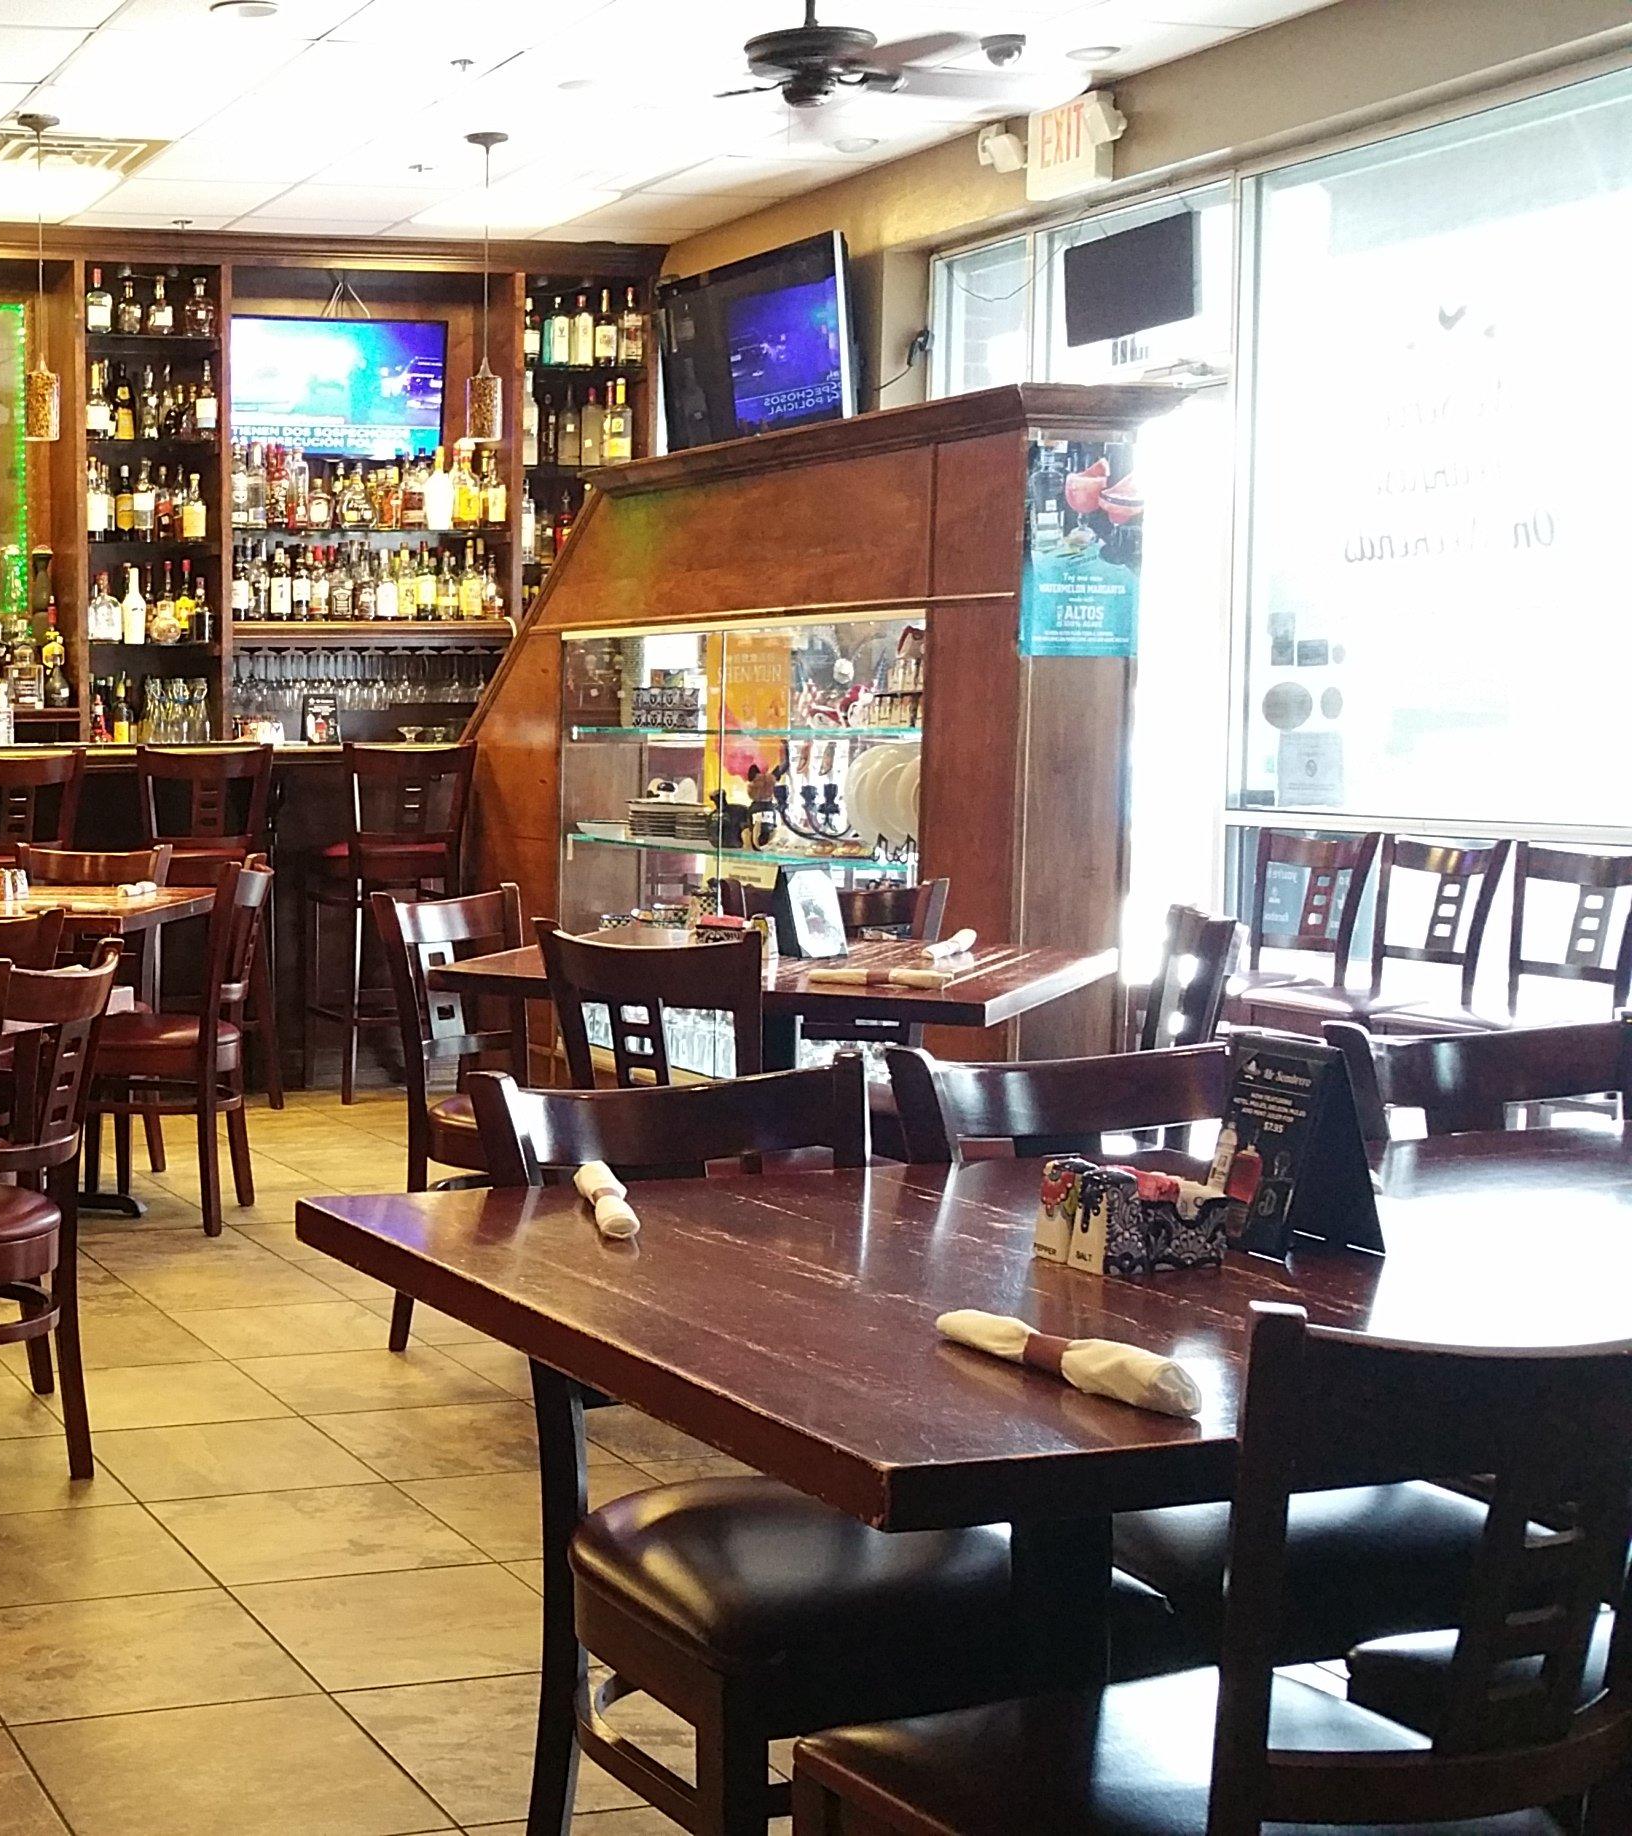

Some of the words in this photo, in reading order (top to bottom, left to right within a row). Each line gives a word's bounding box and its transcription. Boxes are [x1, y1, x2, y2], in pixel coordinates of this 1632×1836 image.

[1040, 102, 1085, 170] EXIT
[1064, 605, 1105, 620] ALTOS
[1075, 1250, 1092, 1261] SALT
